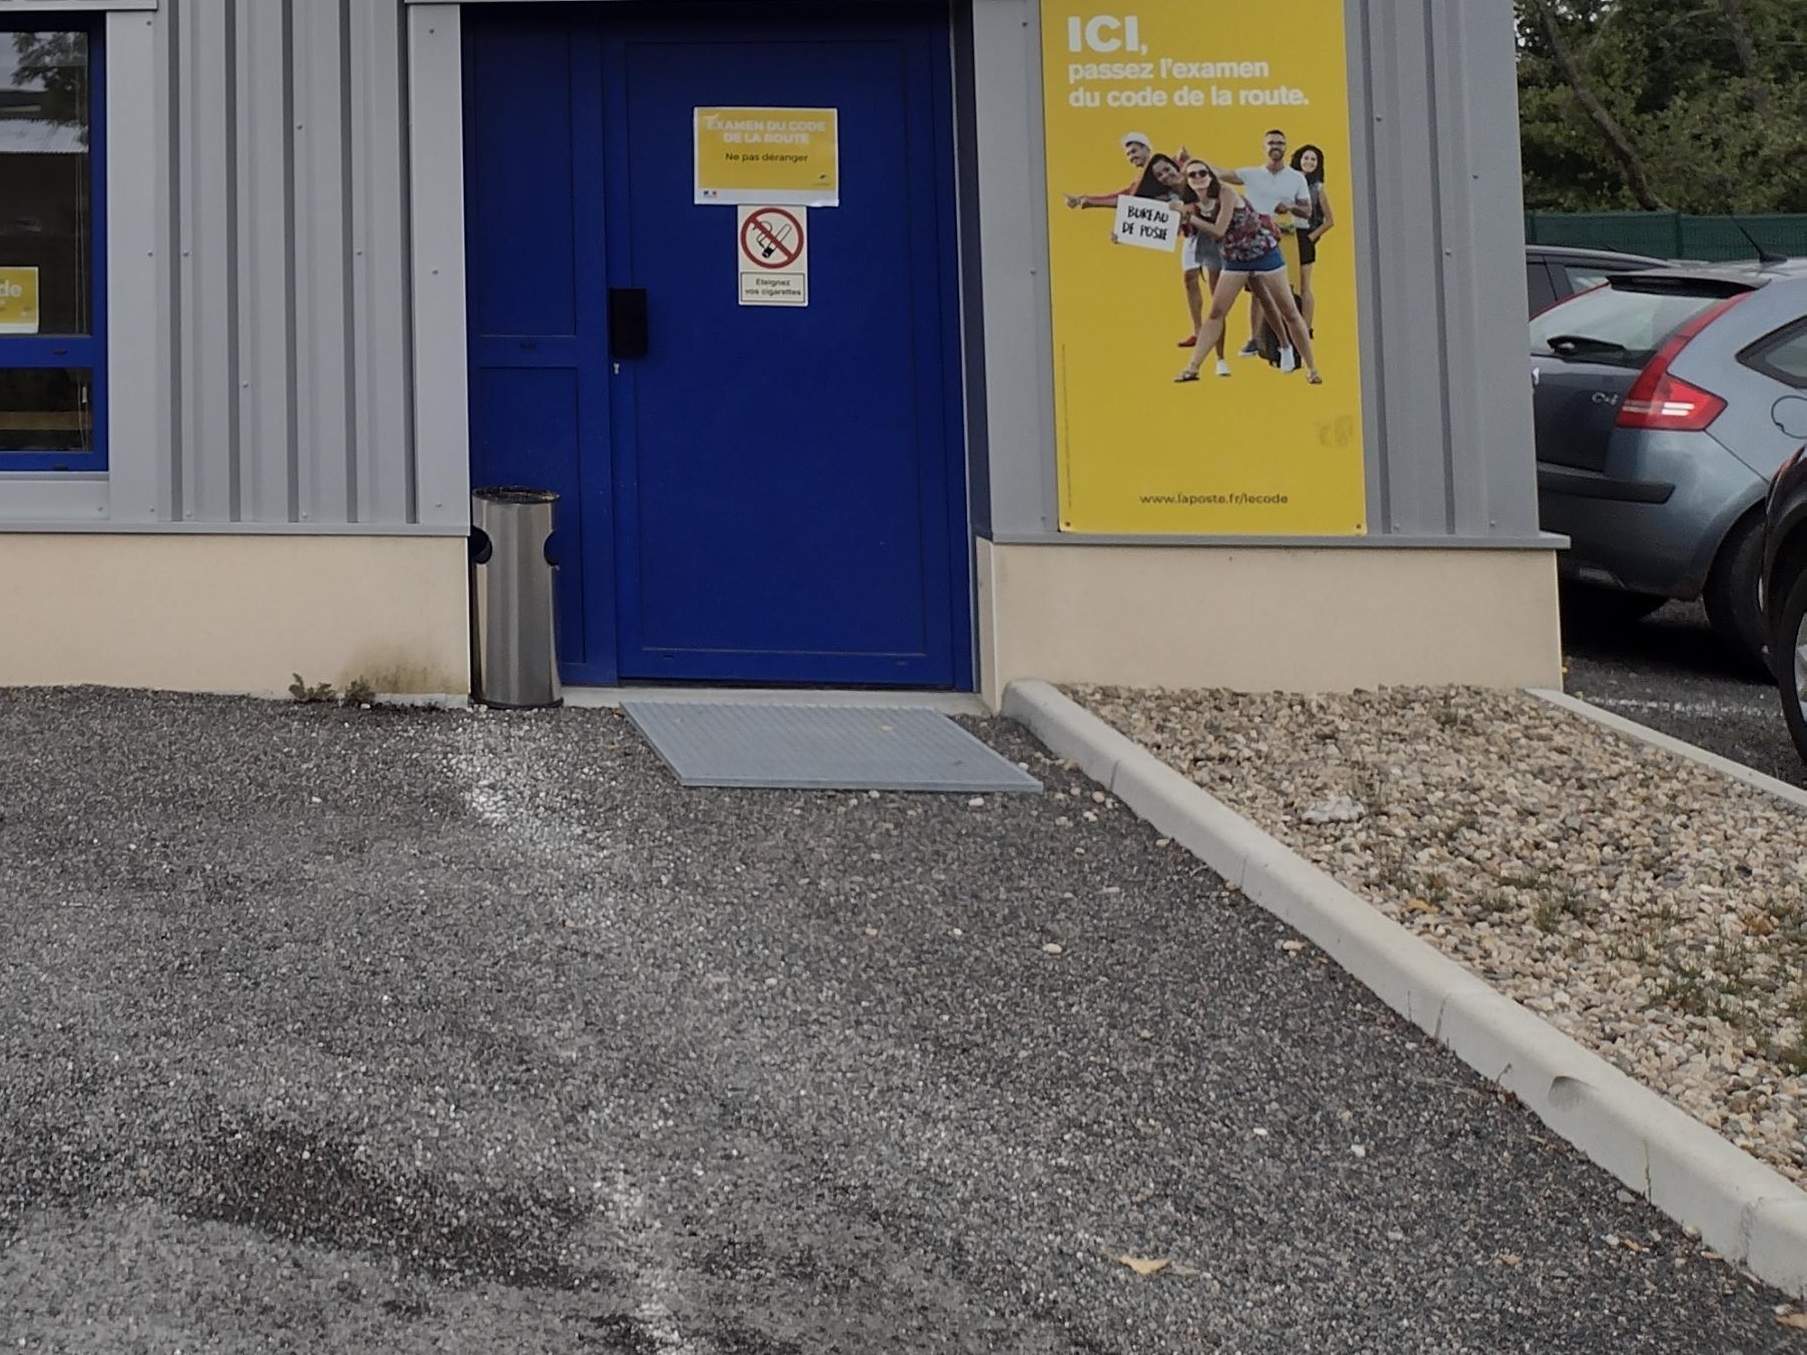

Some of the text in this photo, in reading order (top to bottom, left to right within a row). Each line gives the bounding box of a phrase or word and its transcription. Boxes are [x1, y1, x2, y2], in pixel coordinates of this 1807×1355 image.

[1067, 15, 1148, 55] ICI,
[1068, 58, 1270, 84] passez l'examen
[1068, 85, 1309, 107] du code de la route.
[706, 119, 826, 132] EXAMEN DU CODE
[723, 132, 809, 144] DE LA ROUTE
[725, 152, 808, 163] Ne pas déranger
[1127, 205, 1169, 223] BUREAU
[1122, 221, 1168, 241] DE POSTE
[761, 288, 801, 296] cigarettes
[1140, 493, 1289, 506] www.laposte.fr/lecode
